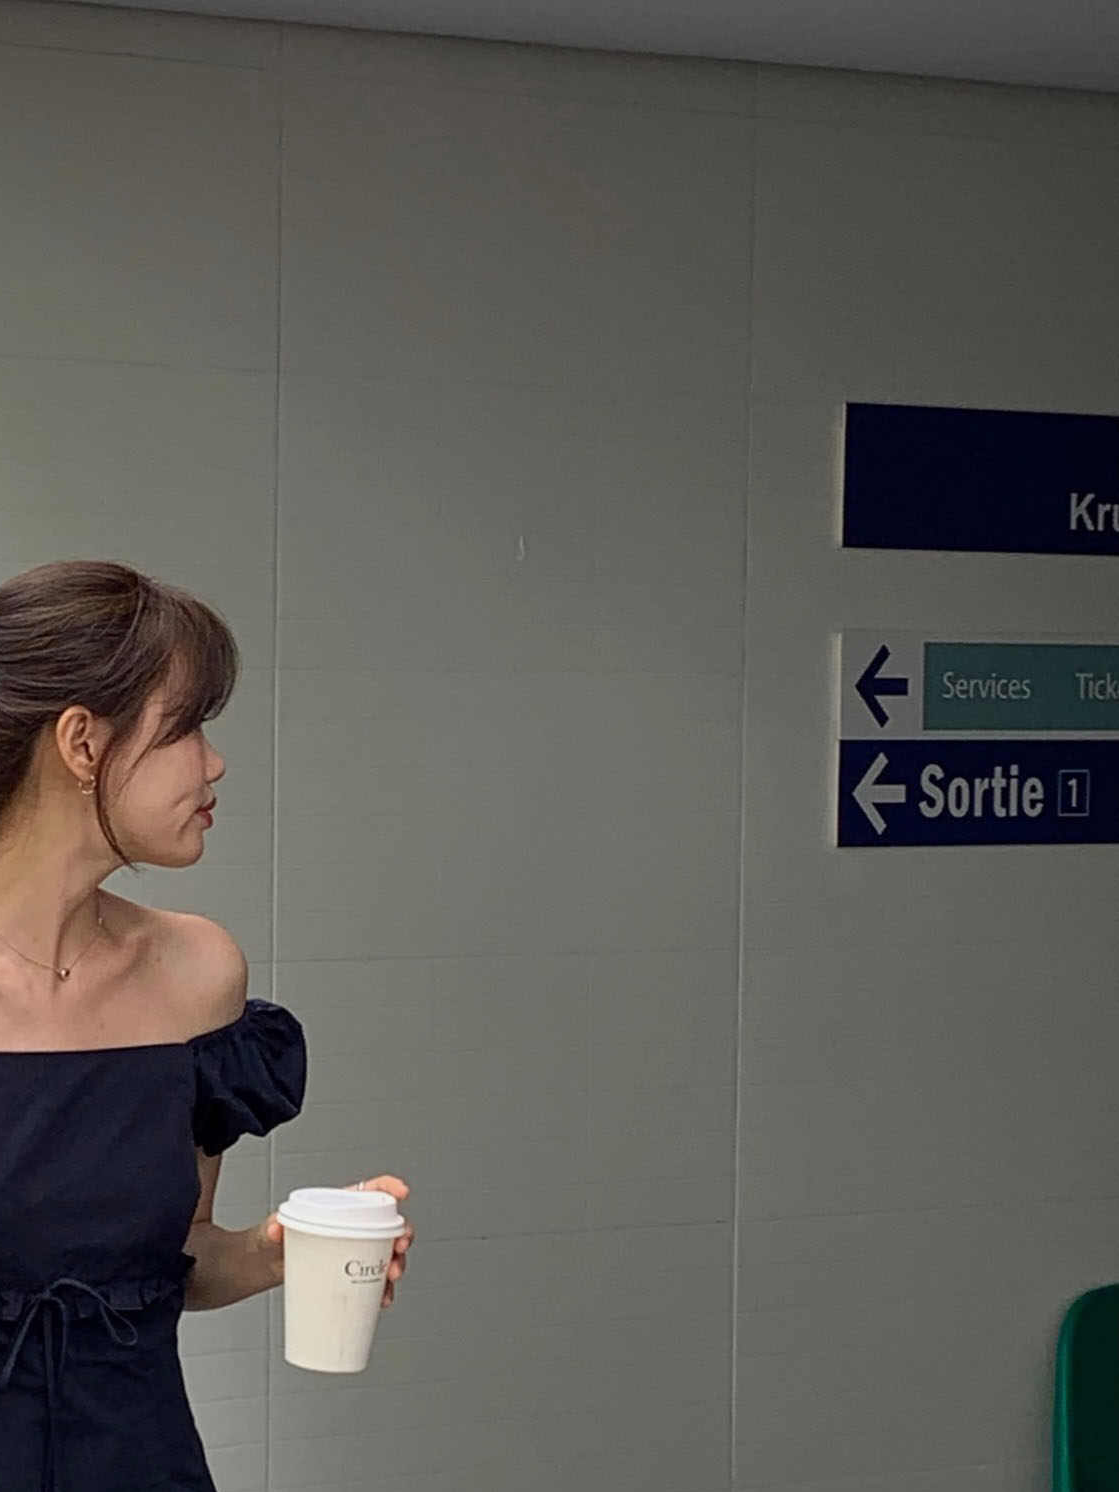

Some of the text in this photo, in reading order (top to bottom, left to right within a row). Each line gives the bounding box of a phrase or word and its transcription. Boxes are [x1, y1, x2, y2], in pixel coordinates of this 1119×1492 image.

[942, 671, 1031, 700] Services
[919, 763, 1078, 818] Sortie 1
